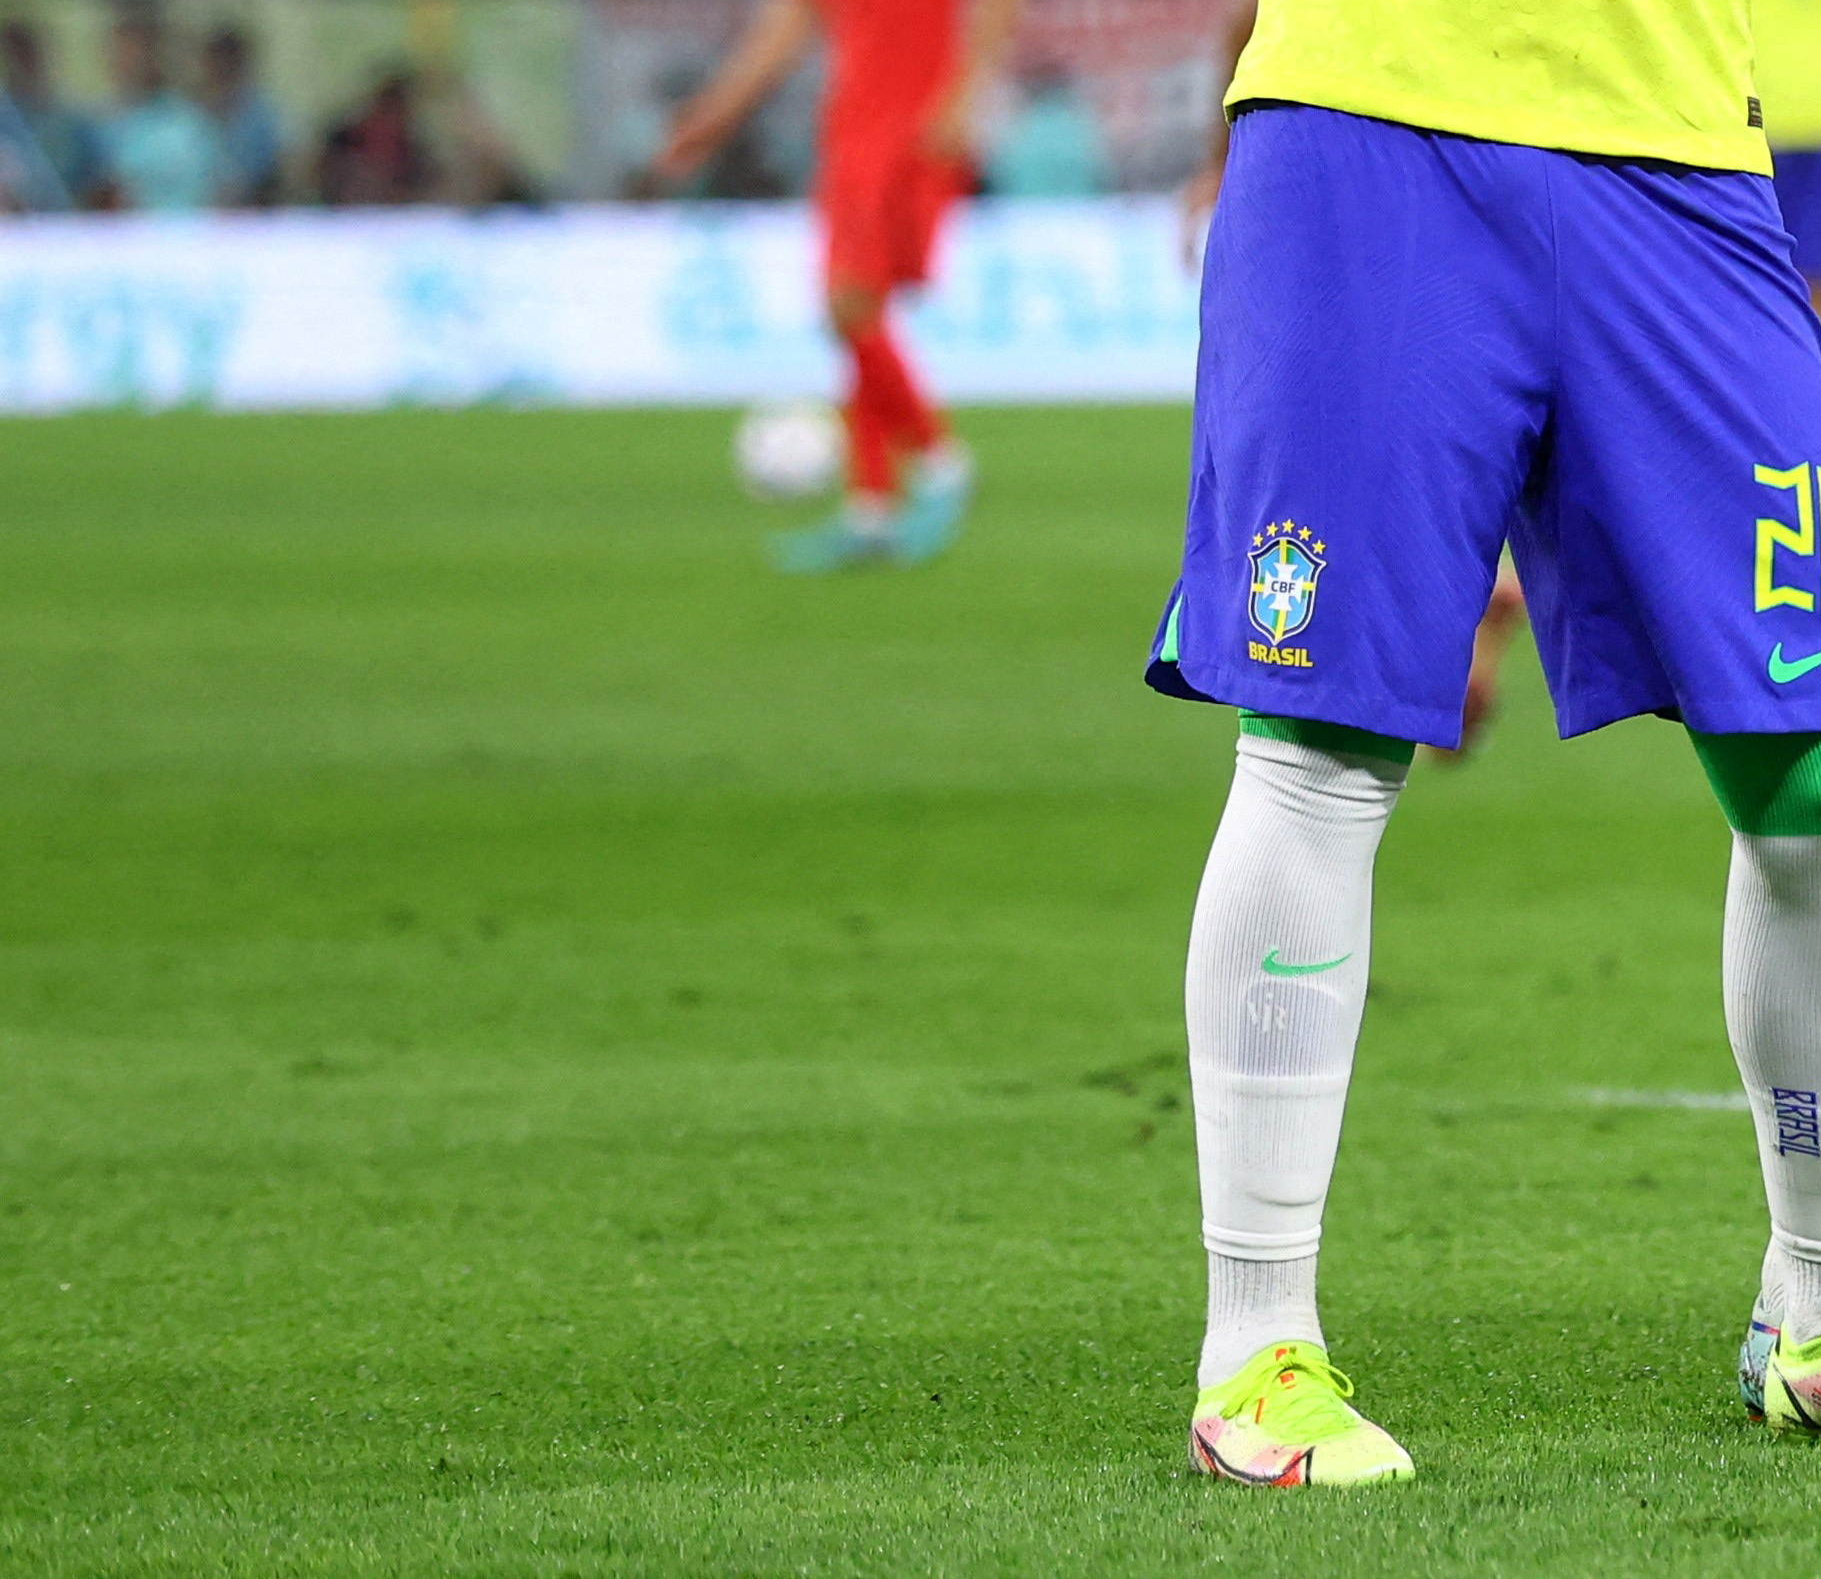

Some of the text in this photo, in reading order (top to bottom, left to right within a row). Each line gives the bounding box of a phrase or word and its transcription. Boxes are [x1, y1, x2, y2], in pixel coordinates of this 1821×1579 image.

[1270, 580, 1296, 593] CBF
[1248, 640, 1314, 668] BRASIL
[1771, 1086, 1821, 1159] BRASIL
